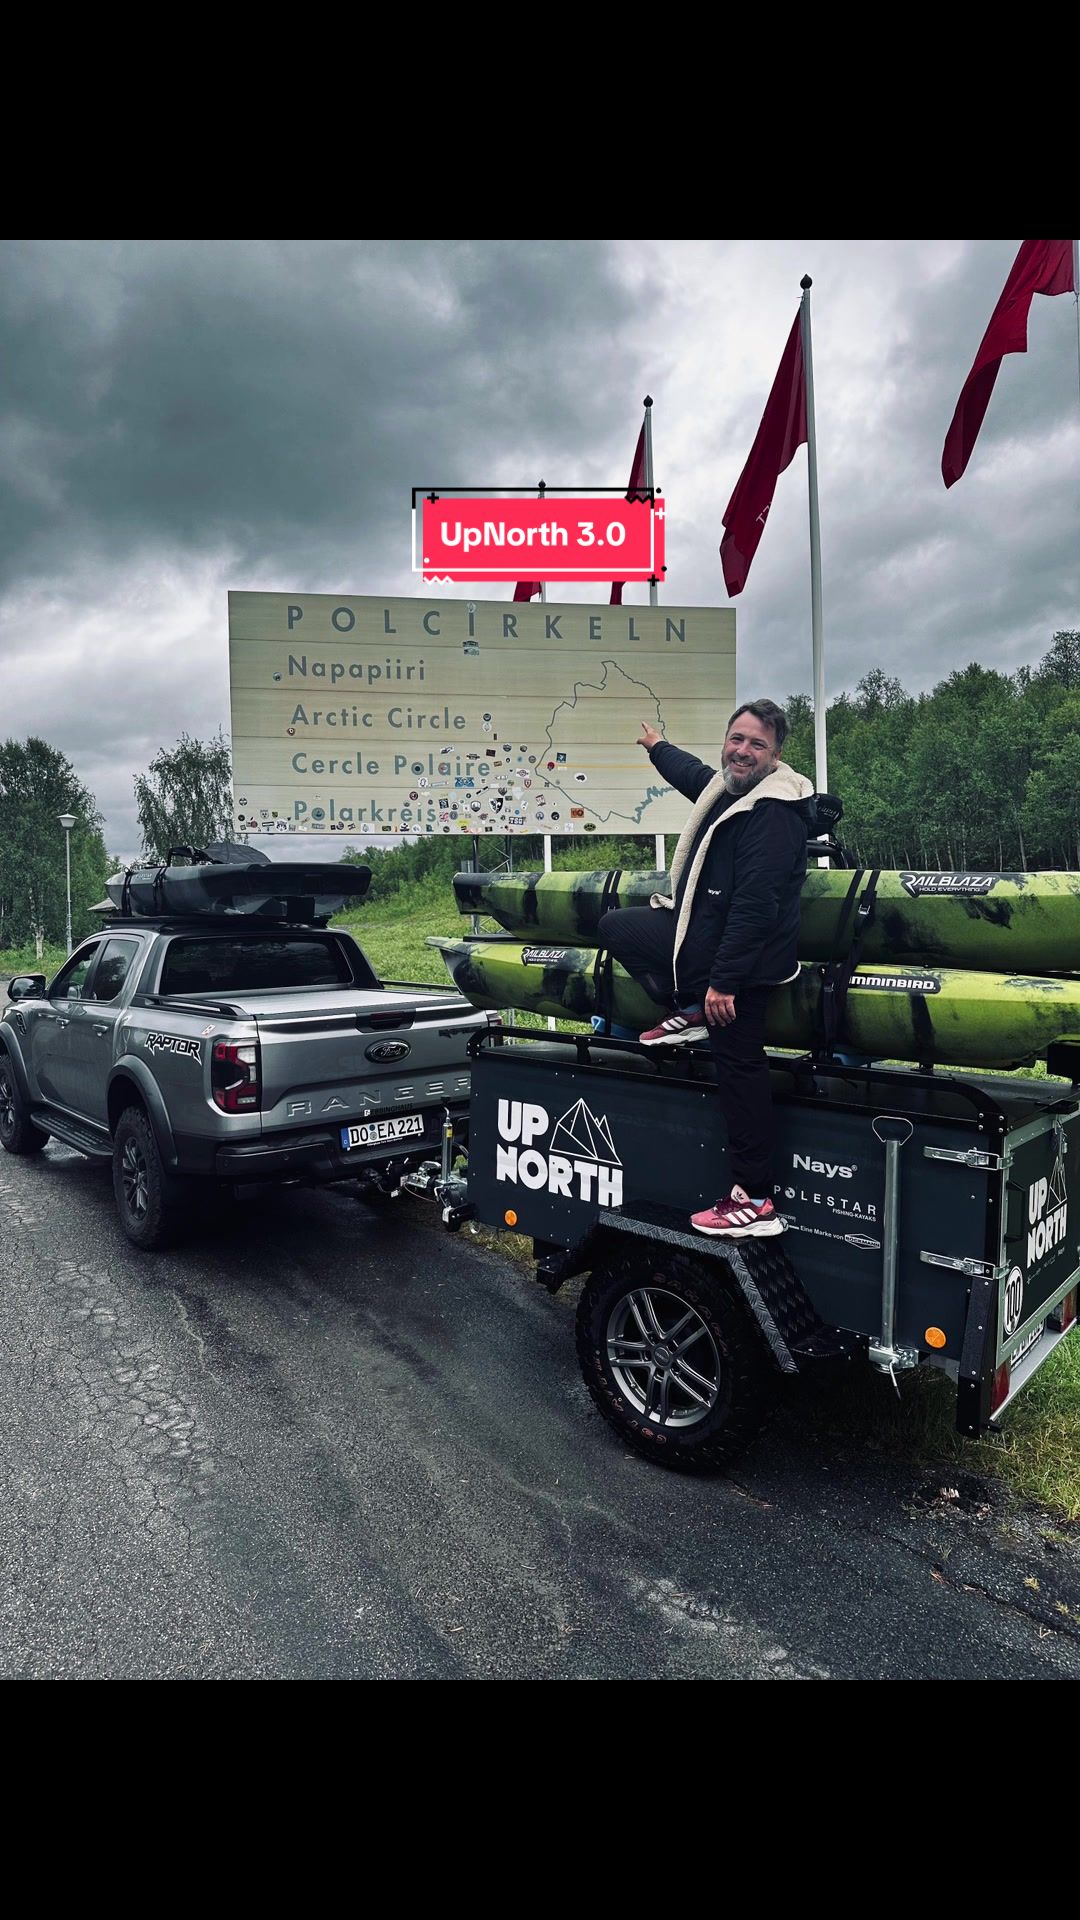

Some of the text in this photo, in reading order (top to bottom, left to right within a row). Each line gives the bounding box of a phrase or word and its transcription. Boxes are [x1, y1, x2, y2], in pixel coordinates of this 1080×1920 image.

[287, 605, 686, 643] POLCIRKELN
[288, 654, 425, 685] Napapiiri
[291, 703, 466, 729] Arctic Circle
[291, 751, 490, 776] Cercle Polaire
[294, 799, 437, 822] Polarkreis
[902, 874, 993, 894] RAILBLAZA
[523, 948, 566, 964] RAILBLAZA
[849, 975, 936, 990] MMINBIRD.
[144, 1032, 202, 1066] RAPTOR
[287, 1076, 471, 1118] RANGER
[350, 1127, 369, 1145] DO
[377, 1123, 396, 1139] EA
[398, 1117, 423, 1136] 221
[497, 1098, 549, 1146] UP
[496, 1143, 623, 1207] NORTH
[773, 1184, 876, 1216] POLESTAR
[832, 1208, 877, 1222] FISHING-KAYAKS
[1028, 1176, 1048, 1225] UP
[800, 1225, 813, 1234] Eine
[813, 1228, 832, 1238] Marke
[833, 1232, 844, 1241] von
[1026, 1203, 1067, 1269] NORTH
[1006, 1275, 1021, 1326] 100
